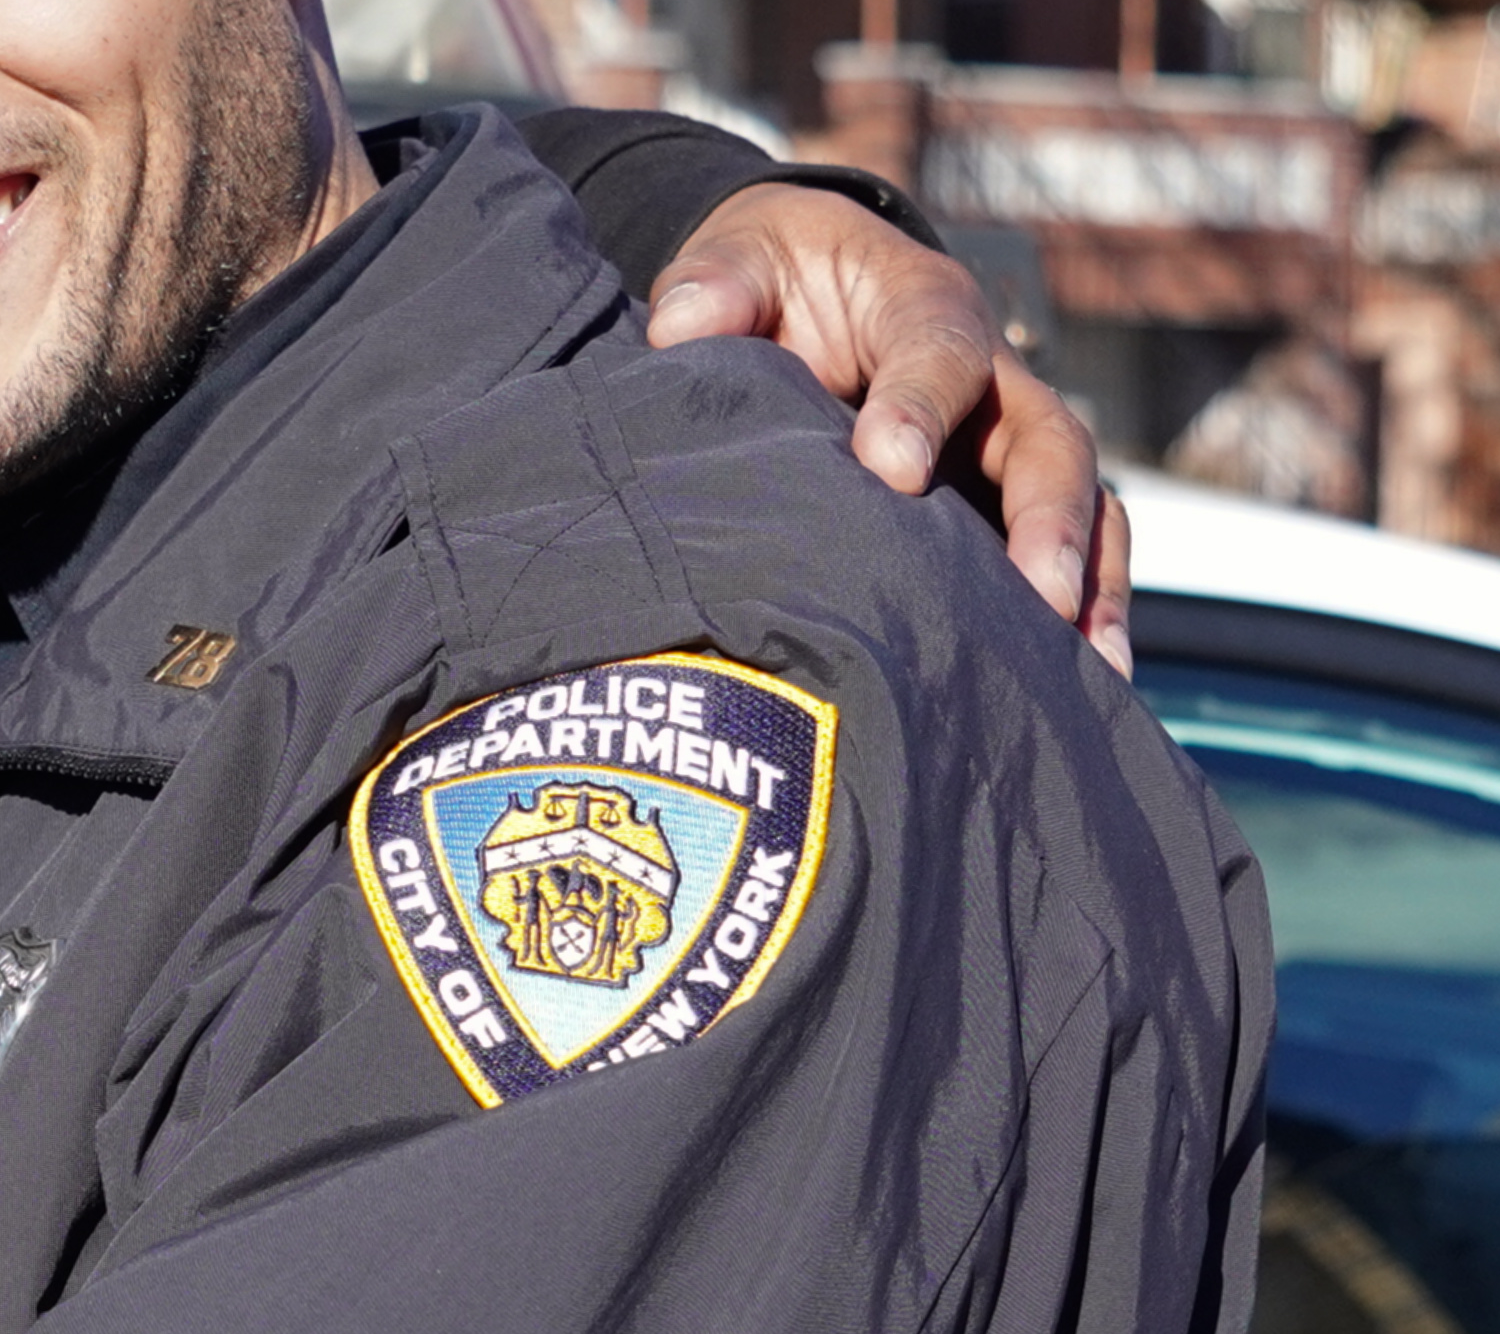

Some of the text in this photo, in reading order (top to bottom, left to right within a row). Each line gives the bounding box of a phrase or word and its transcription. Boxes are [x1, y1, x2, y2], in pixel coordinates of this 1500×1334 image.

[146, 624, 236, 690] 78
[482, 677, 705, 731] POLICE
[392, 719, 784, 811] DEPARTMENT
[379, 838, 793, 1072] CITY OF EW YORK
